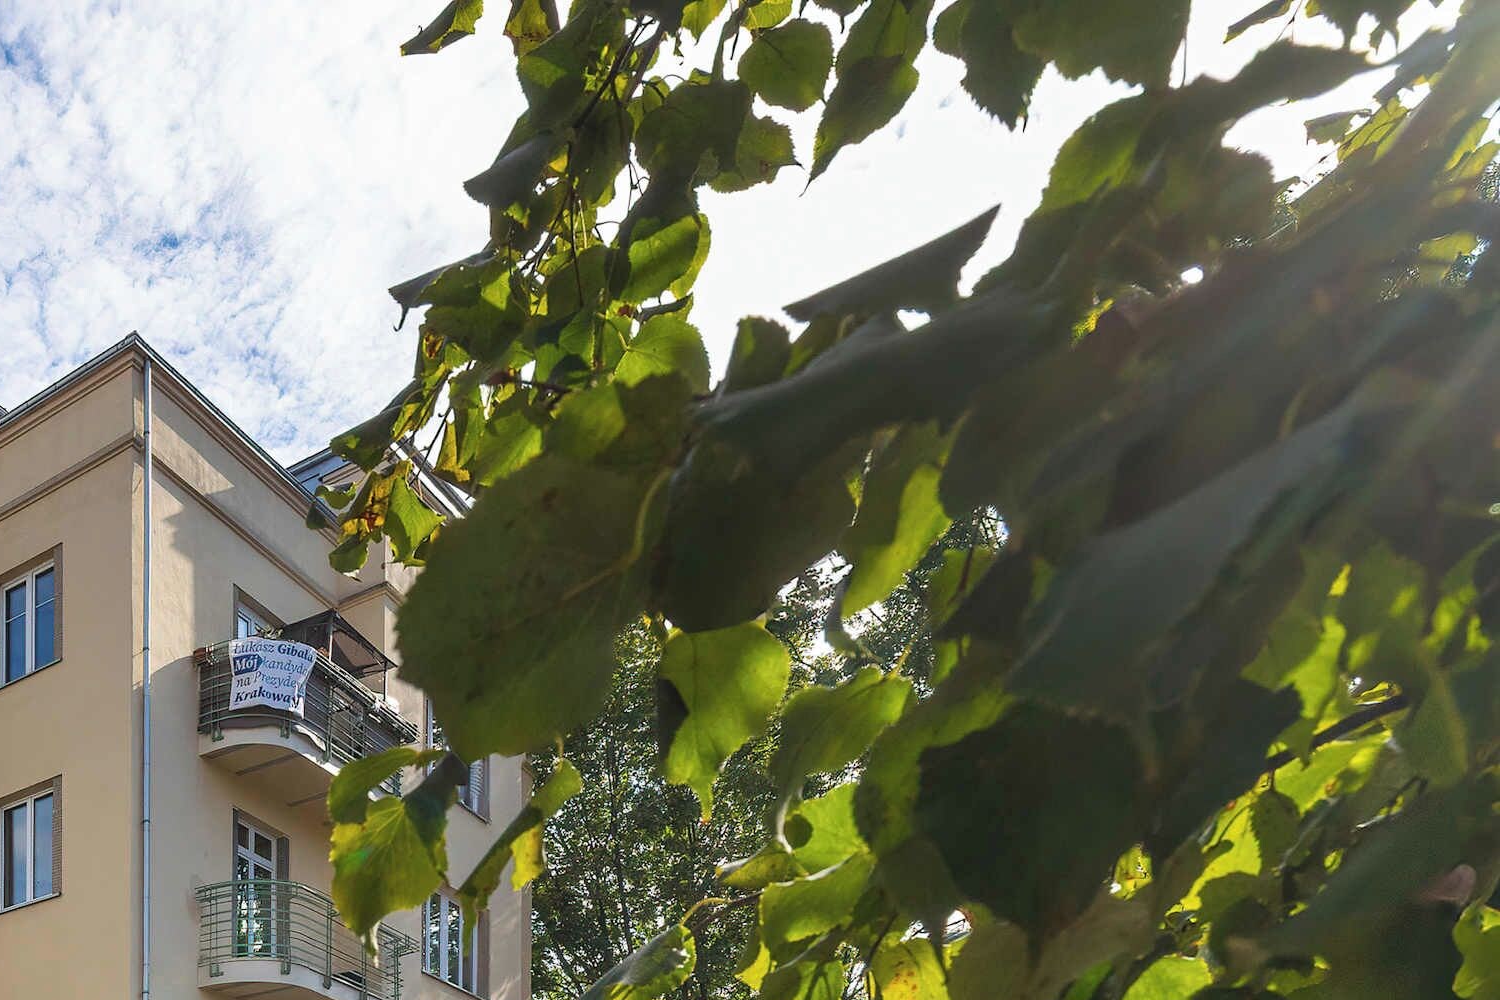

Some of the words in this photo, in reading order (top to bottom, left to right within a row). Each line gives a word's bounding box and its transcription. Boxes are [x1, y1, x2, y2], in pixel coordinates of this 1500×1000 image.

[234, 641, 275, 654] Łukasz
[235, 655, 258, 673] Mój
[261, 656, 308, 675] kandyda
[236, 676, 251, 688] na
[253, 671, 298, 689] Prezyde
